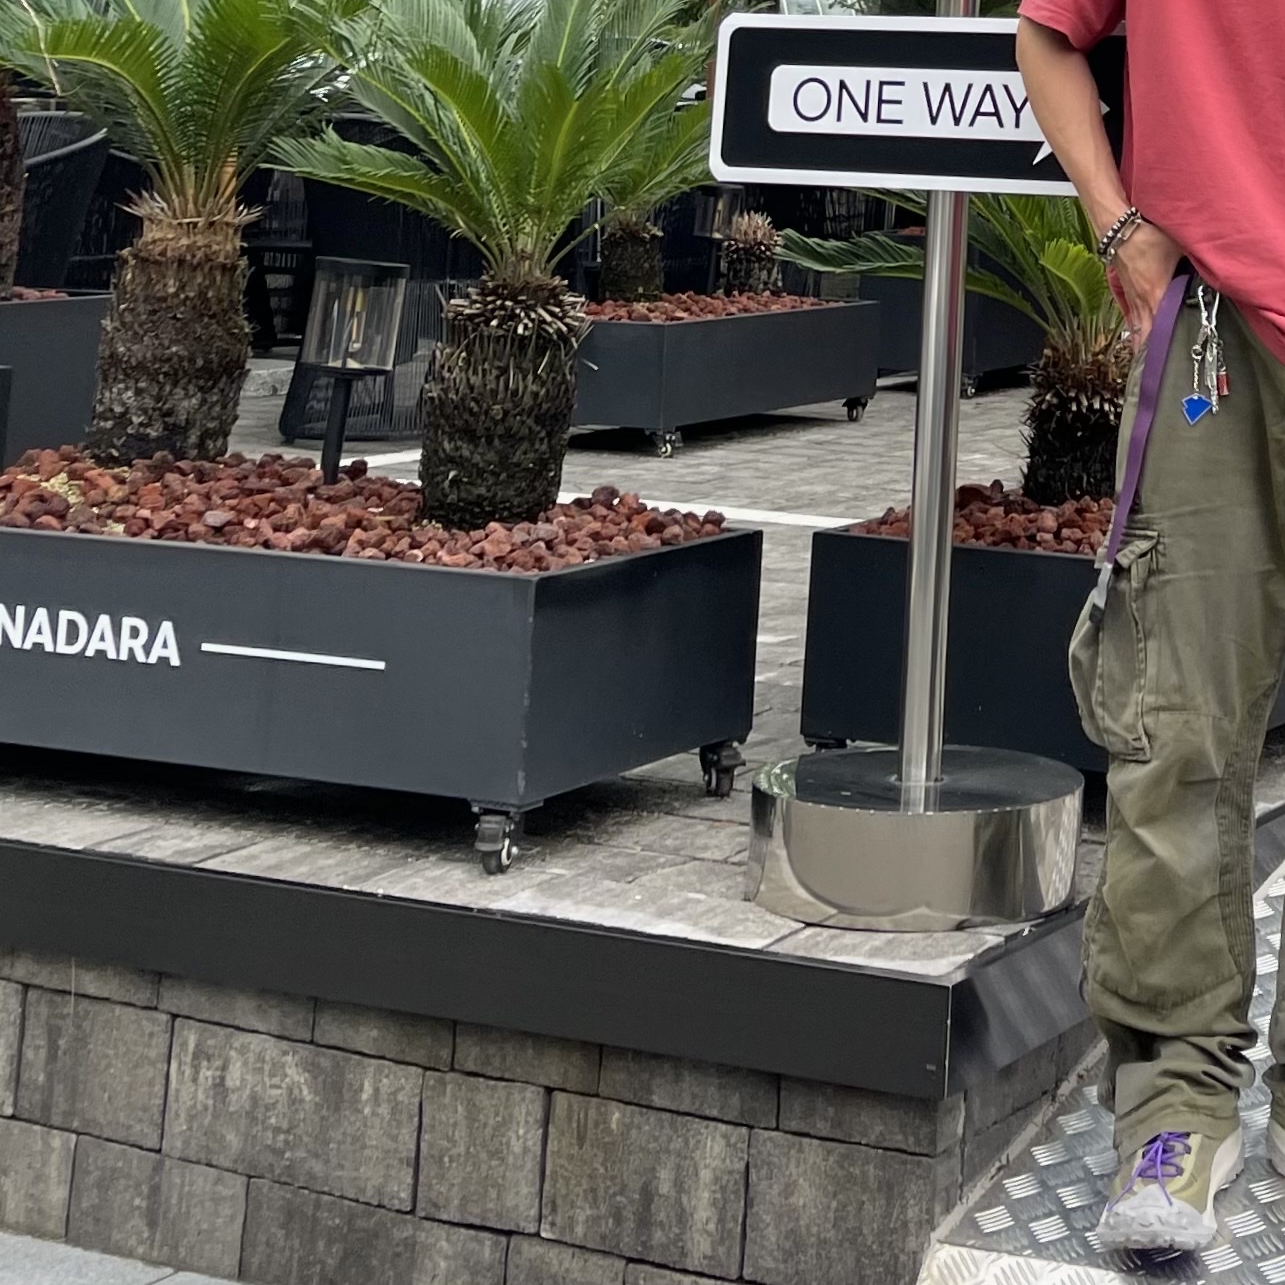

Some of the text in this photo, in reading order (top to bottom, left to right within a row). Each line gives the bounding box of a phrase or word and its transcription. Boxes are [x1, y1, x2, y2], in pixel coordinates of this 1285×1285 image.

[793, 77, 1030, 129] ONE WAY
[0, 603, 181, 666] NADARA
